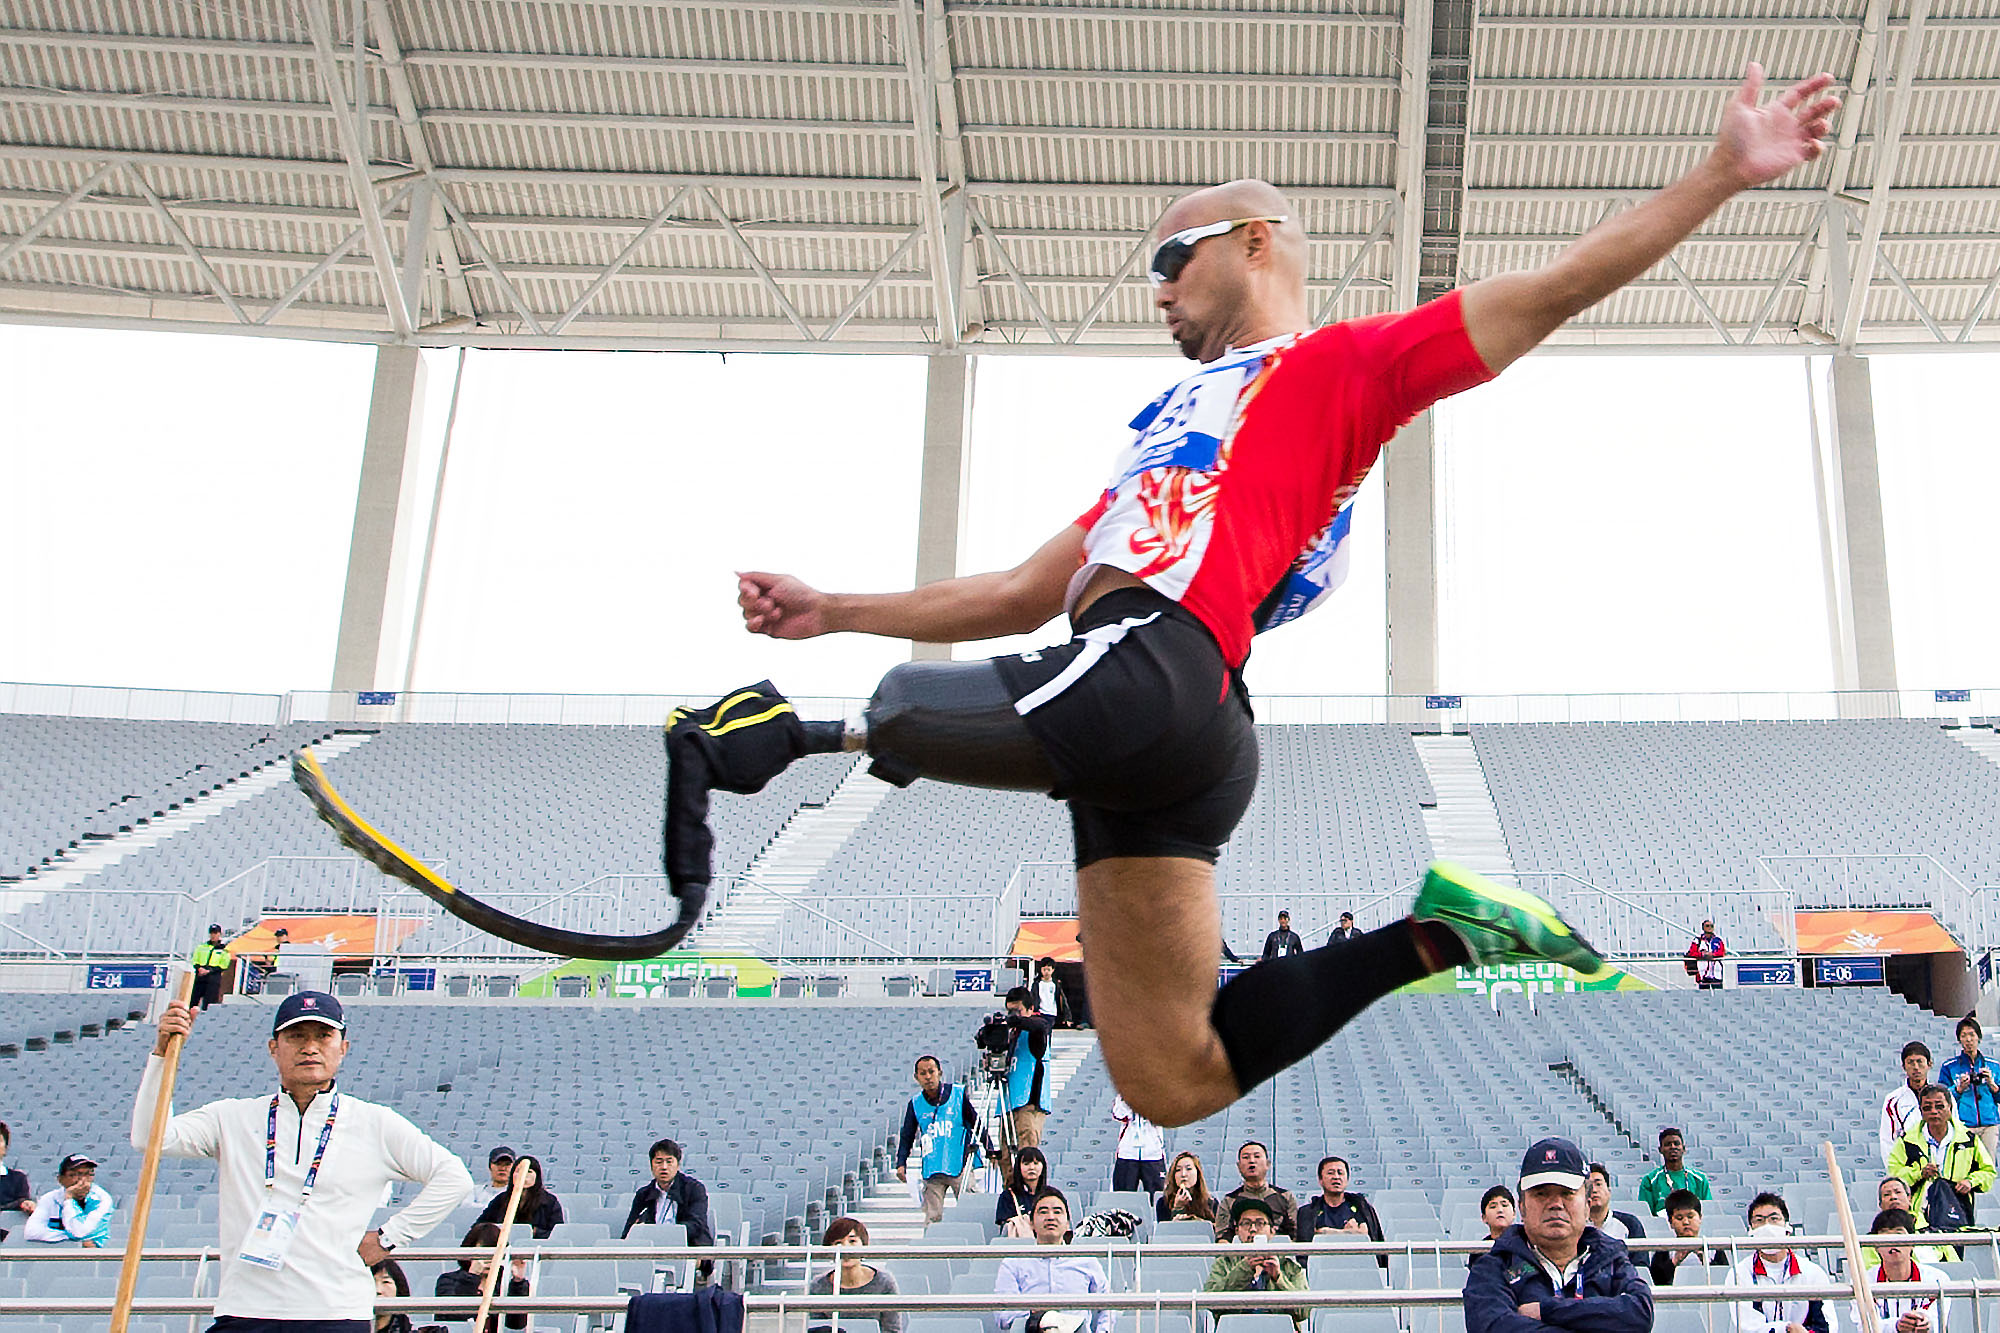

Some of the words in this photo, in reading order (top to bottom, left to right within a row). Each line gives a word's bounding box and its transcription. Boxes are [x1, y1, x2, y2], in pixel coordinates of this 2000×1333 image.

[91, 973, 122, 987] E-04
[1763, 970, 1790, 983] E-22
[1823, 966, 1852, 981] E-06
[959, 976, 986, 990] E-21
